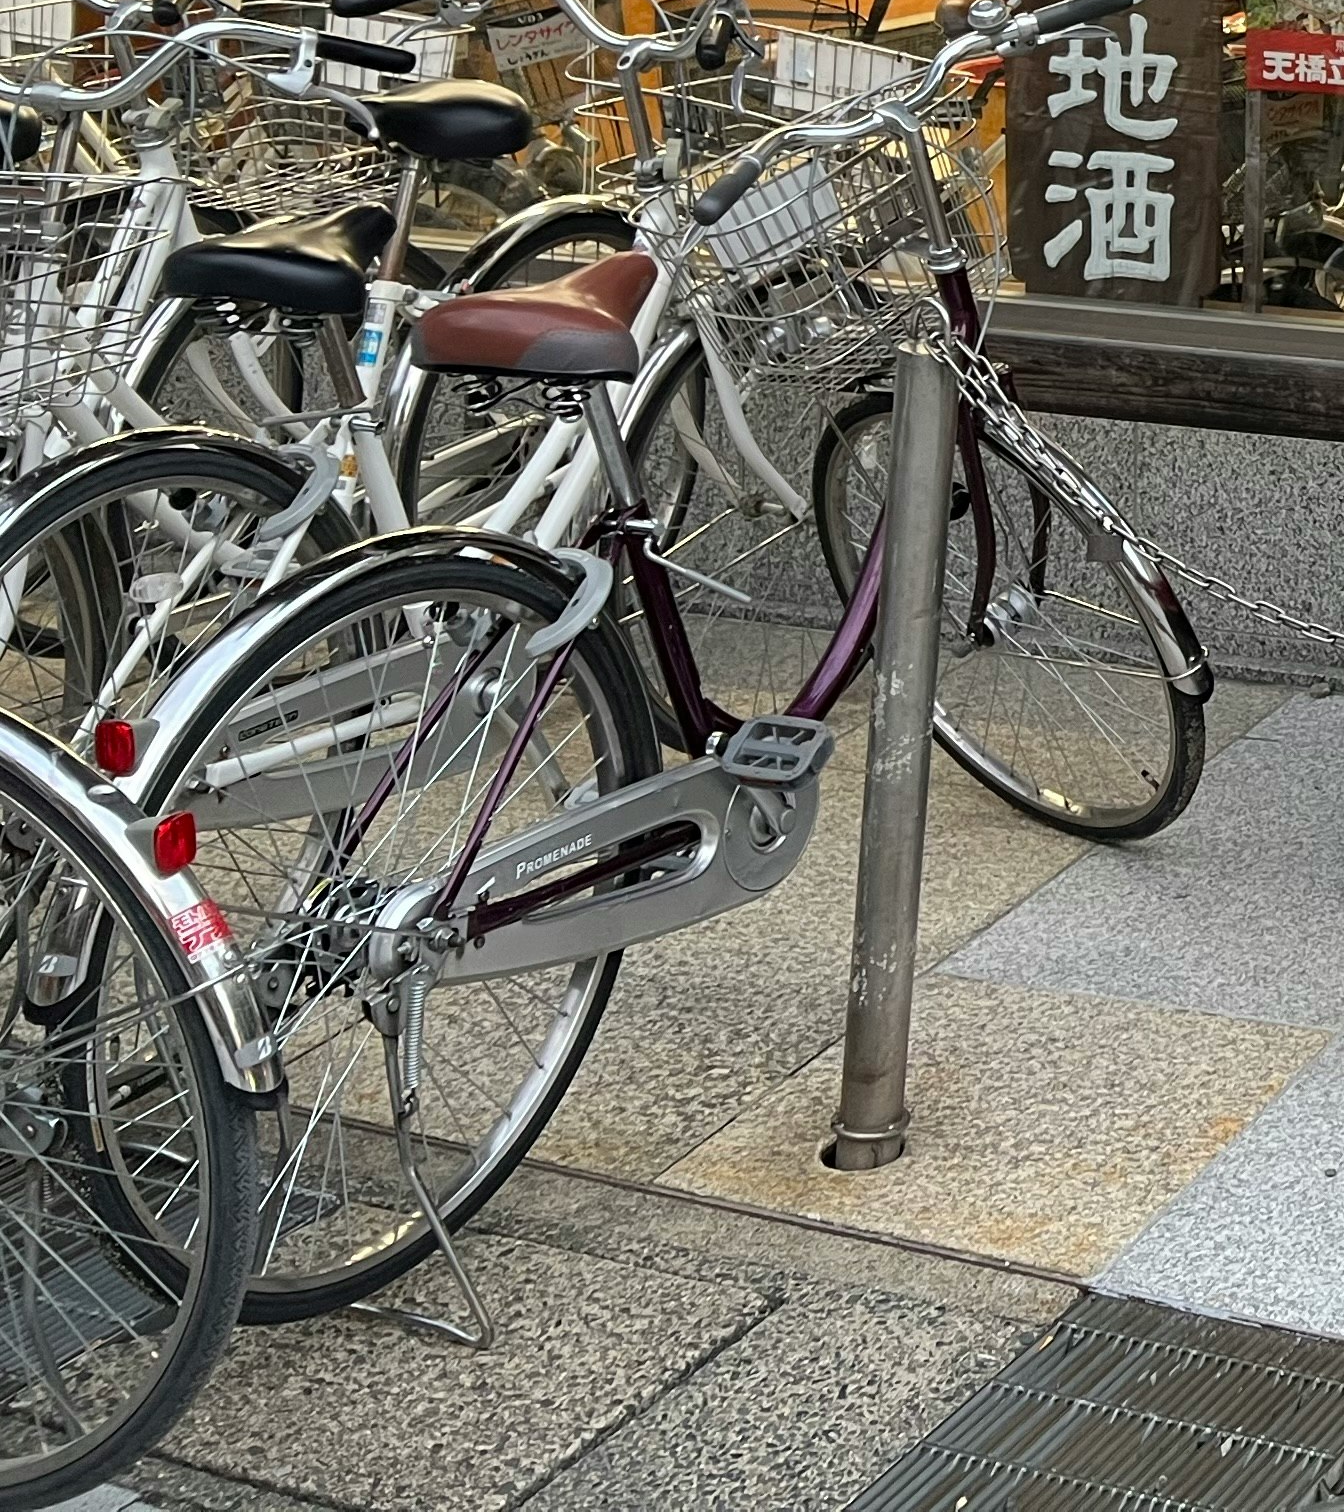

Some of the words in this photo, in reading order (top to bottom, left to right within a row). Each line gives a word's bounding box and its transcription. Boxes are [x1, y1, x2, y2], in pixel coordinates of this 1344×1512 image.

[496, 20, 576, 50] レンタサイク
[516, 833, 593, 879] PROMENADE
